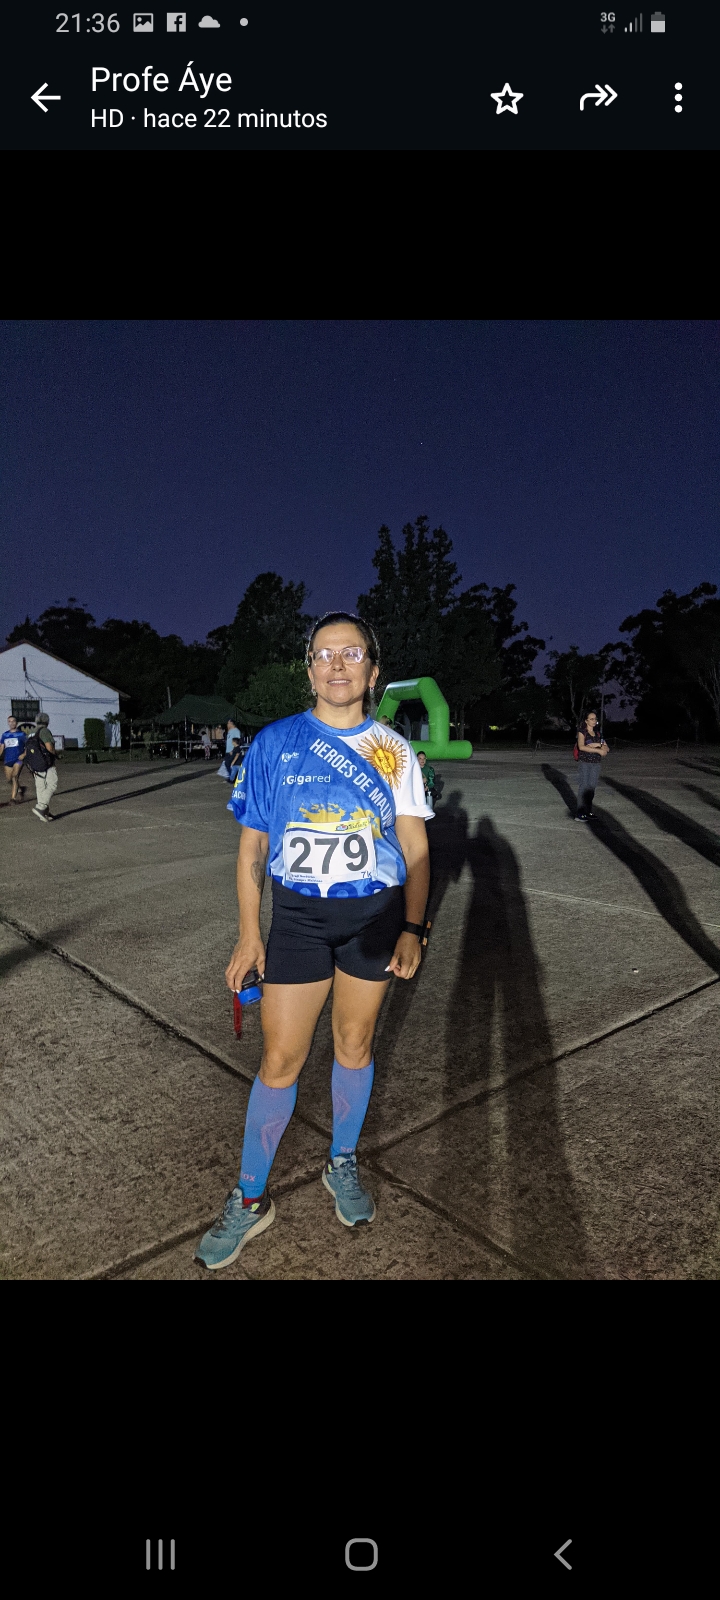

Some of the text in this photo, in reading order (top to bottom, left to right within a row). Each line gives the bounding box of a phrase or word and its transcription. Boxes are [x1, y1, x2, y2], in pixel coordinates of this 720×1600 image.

[309, 738, 358, 778] HEROES
[352, 772, 374, 793] DE
[289, 833, 369, 875] 279
